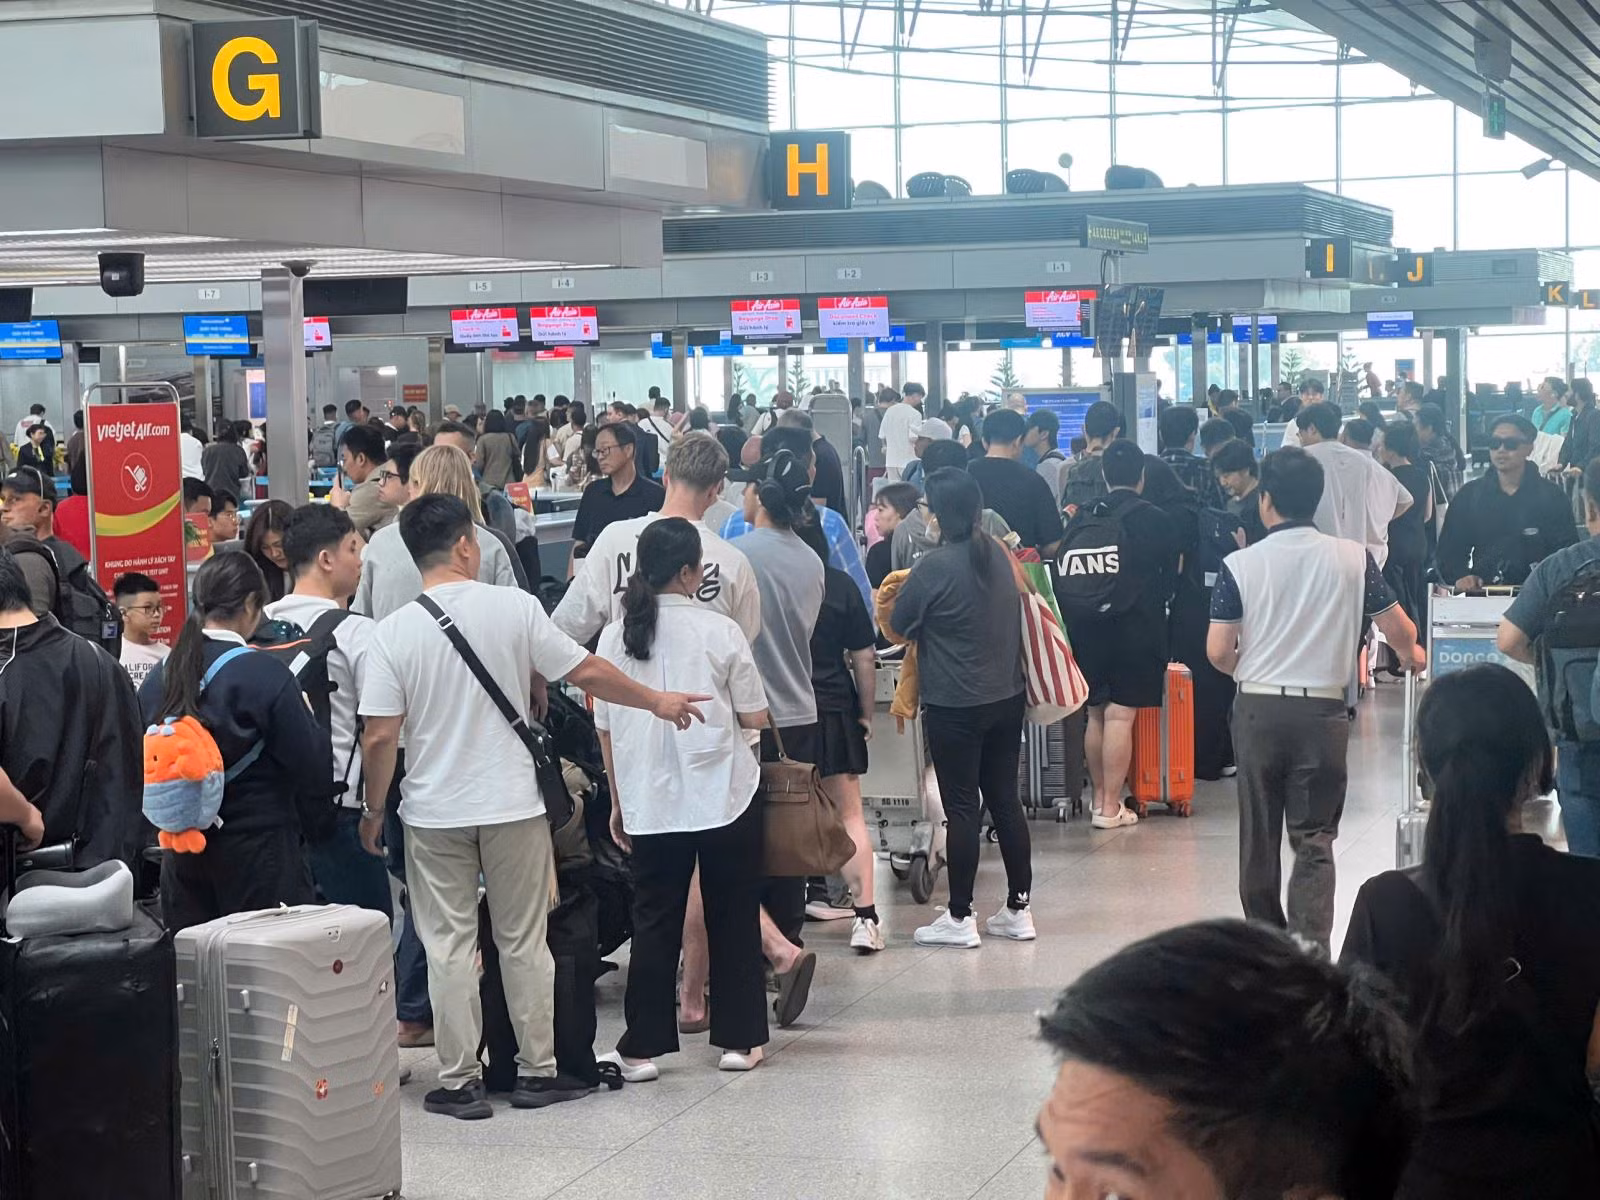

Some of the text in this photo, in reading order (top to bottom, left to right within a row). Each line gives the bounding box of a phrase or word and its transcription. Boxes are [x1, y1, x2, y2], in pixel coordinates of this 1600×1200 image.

[211, 36, 281, 123] G
[786, 142, 830, 197] H
[1325, 243, 1334, 273] I
[844, 269, 857, 278] I-2
[1053, 263, 1065, 271] I-1
[1407, 256, 1424, 282] J
[756, 272, 769, 280] I-3
[475, 282, 487, 290] I-5
[557, 279, 570, 287] I-4
[203, 289, 216, 298] I-7
[1548, 285, 1564, 302] K
[1584, 291, 1597, 308] L
[1056, 545, 1120, 577] VANS
[124, 662, 153, 672] ALIFOR
